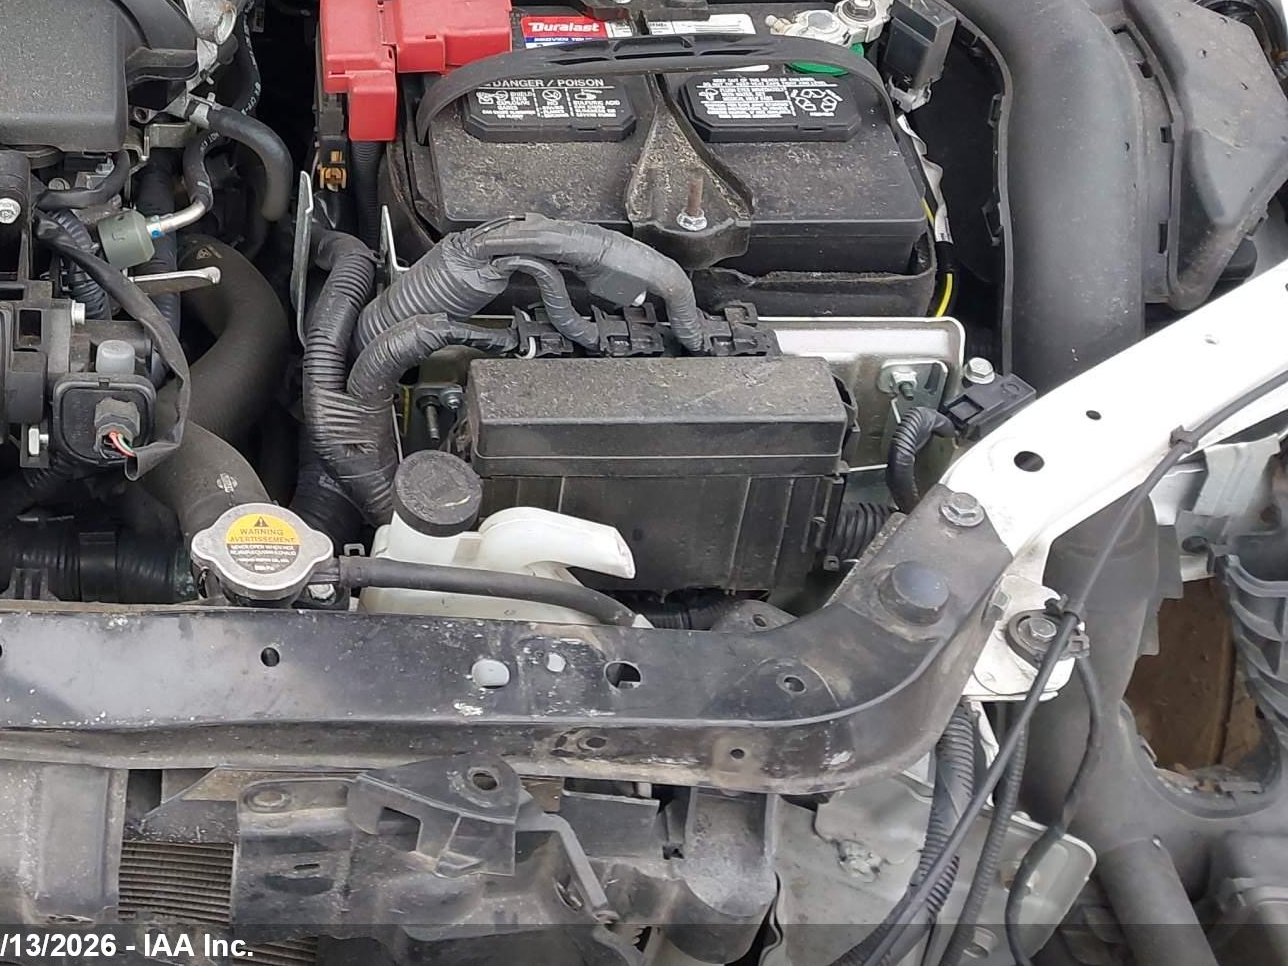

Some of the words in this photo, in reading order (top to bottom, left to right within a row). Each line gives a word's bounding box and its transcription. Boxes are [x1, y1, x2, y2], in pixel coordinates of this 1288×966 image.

[528, 21, 600, 32] Duralast
[492, 79, 544, 87] DANGER
[546, 79, 554, 87] /
[557, 78, 604, 87] POISON
[240, 528, 284, 536] WARNING
